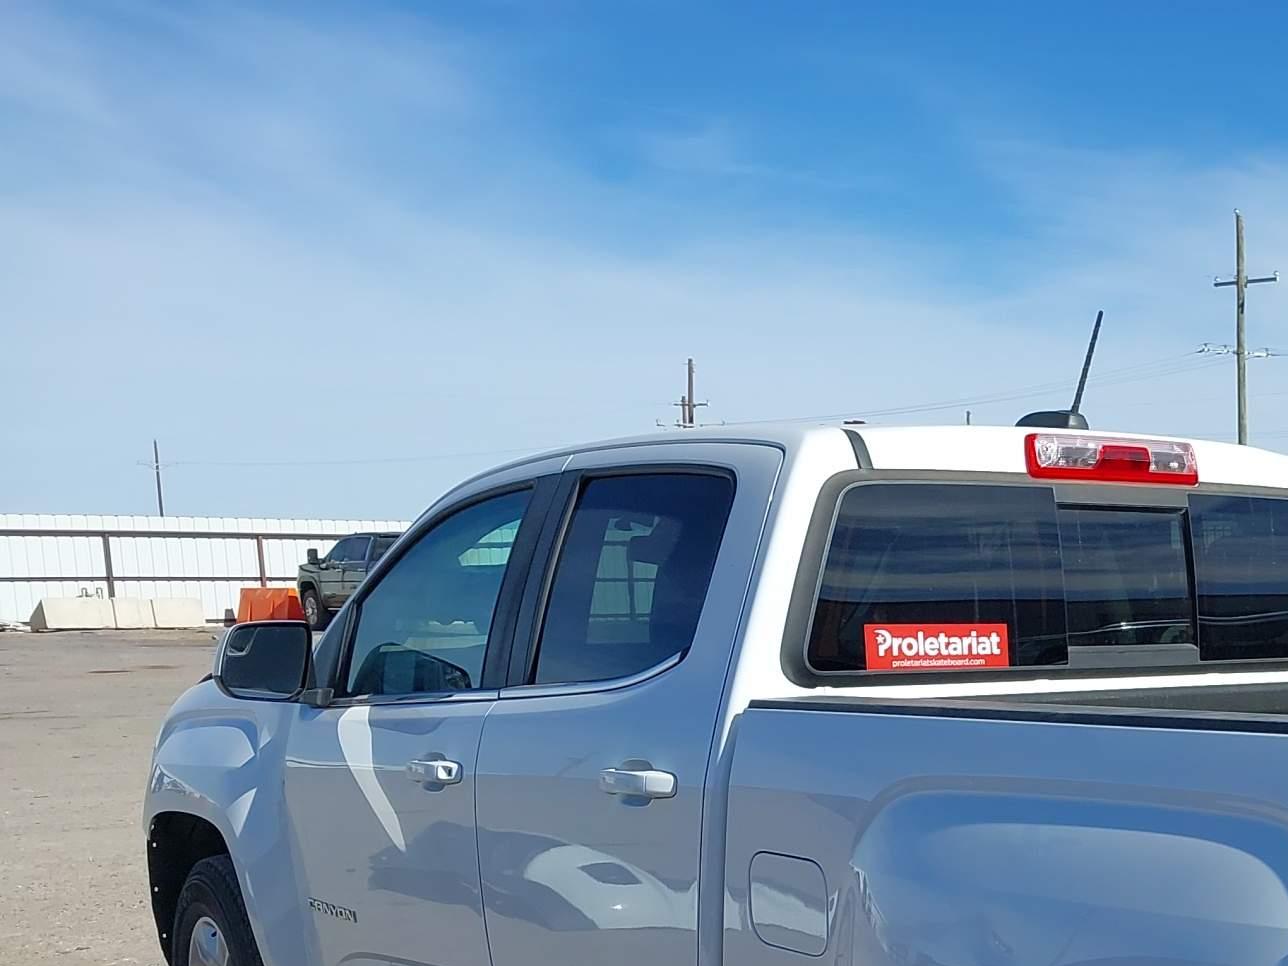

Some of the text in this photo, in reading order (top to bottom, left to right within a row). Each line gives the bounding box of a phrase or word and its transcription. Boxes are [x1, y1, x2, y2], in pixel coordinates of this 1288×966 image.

[874, 629, 1001, 657] Proletariat
[892, 658, 986, 668] proletariatskateboard.com
[307, 897, 358, 923] CANYON
